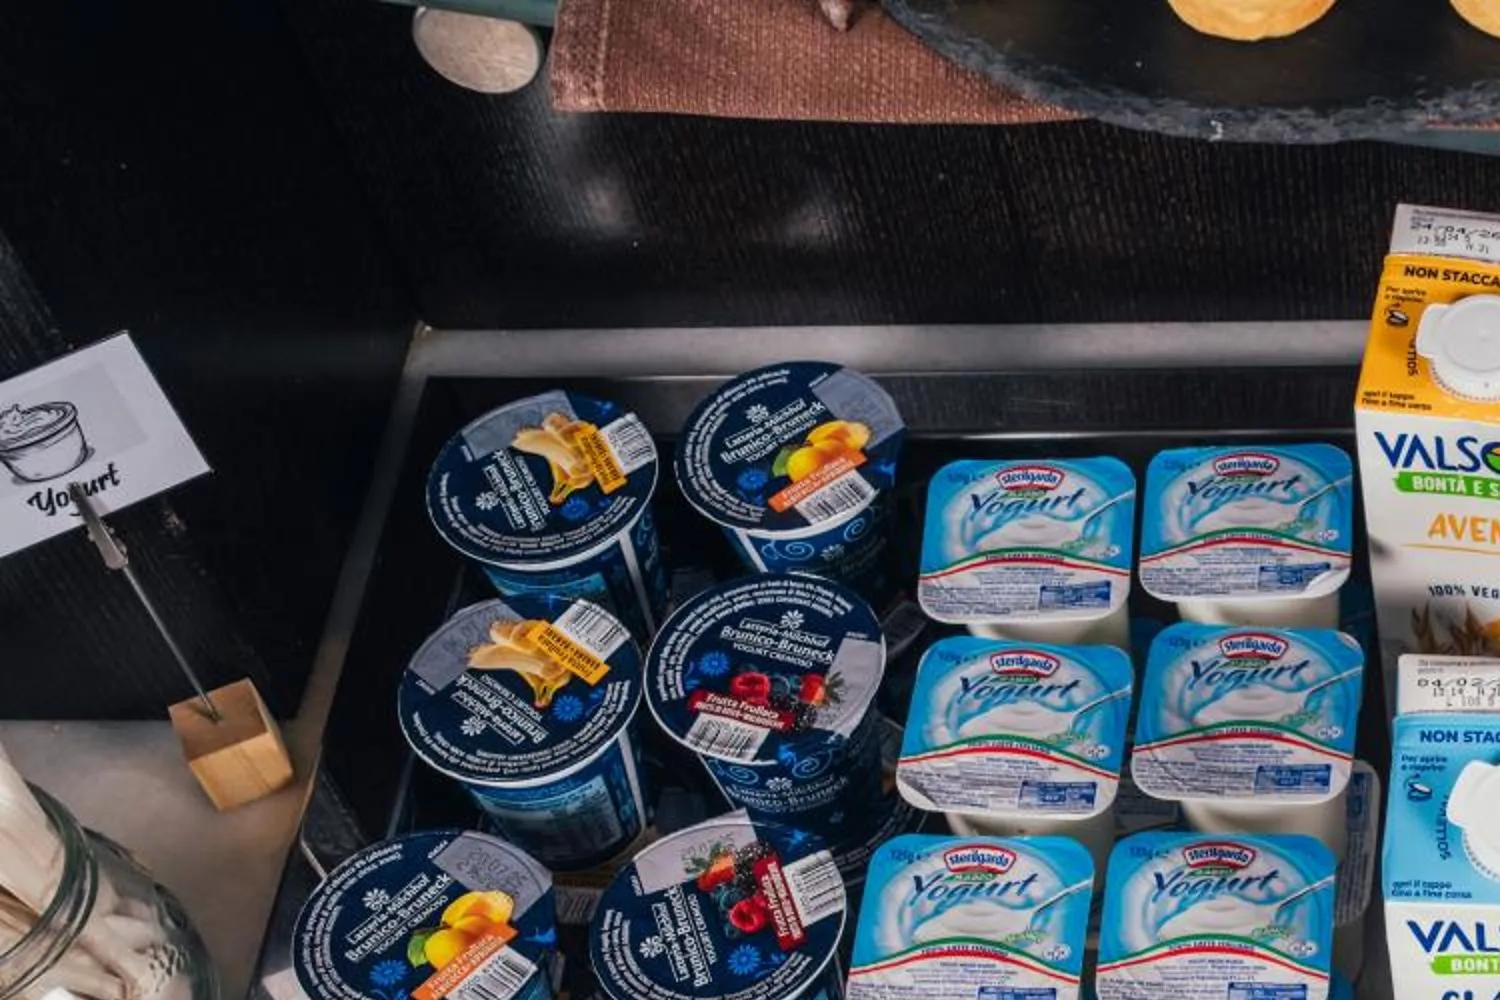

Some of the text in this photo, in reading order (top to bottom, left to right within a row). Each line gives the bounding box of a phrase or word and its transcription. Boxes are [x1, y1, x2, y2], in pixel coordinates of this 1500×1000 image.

[1404, 266, 1438, 279] NON
[721, 401, 826, 464] Brunico-Bruneck
[27, 464, 120, 516] Yourt
[1187, 474, 1300, 505] Yogurt
[1412, 475, 1467, 493] BONTÀ
[1474, 480, 1483, 494] E
[970, 488, 1086, 523] Yogurt
[1428, 584, 1465, 598] 100%
[720, 625, 834, 664] Brunico-Bruneck
[1223, 637, 1283, 656] sterilgarda
[1190, 657, 1309, 690] Yogurt
[958, 675, 1082, 707] Yogurt
[1420, 730, 1458, 743] NON
[950, 850, 1010, 867] sterilgarda
[1188, 848, 1250, 865] sterilgarda
[912, 873, 1039, 908] Yogurt
[1152, 869, 1278, 904] Yogurt
[344, 874, 451, 963] Brunico-Bruneck
